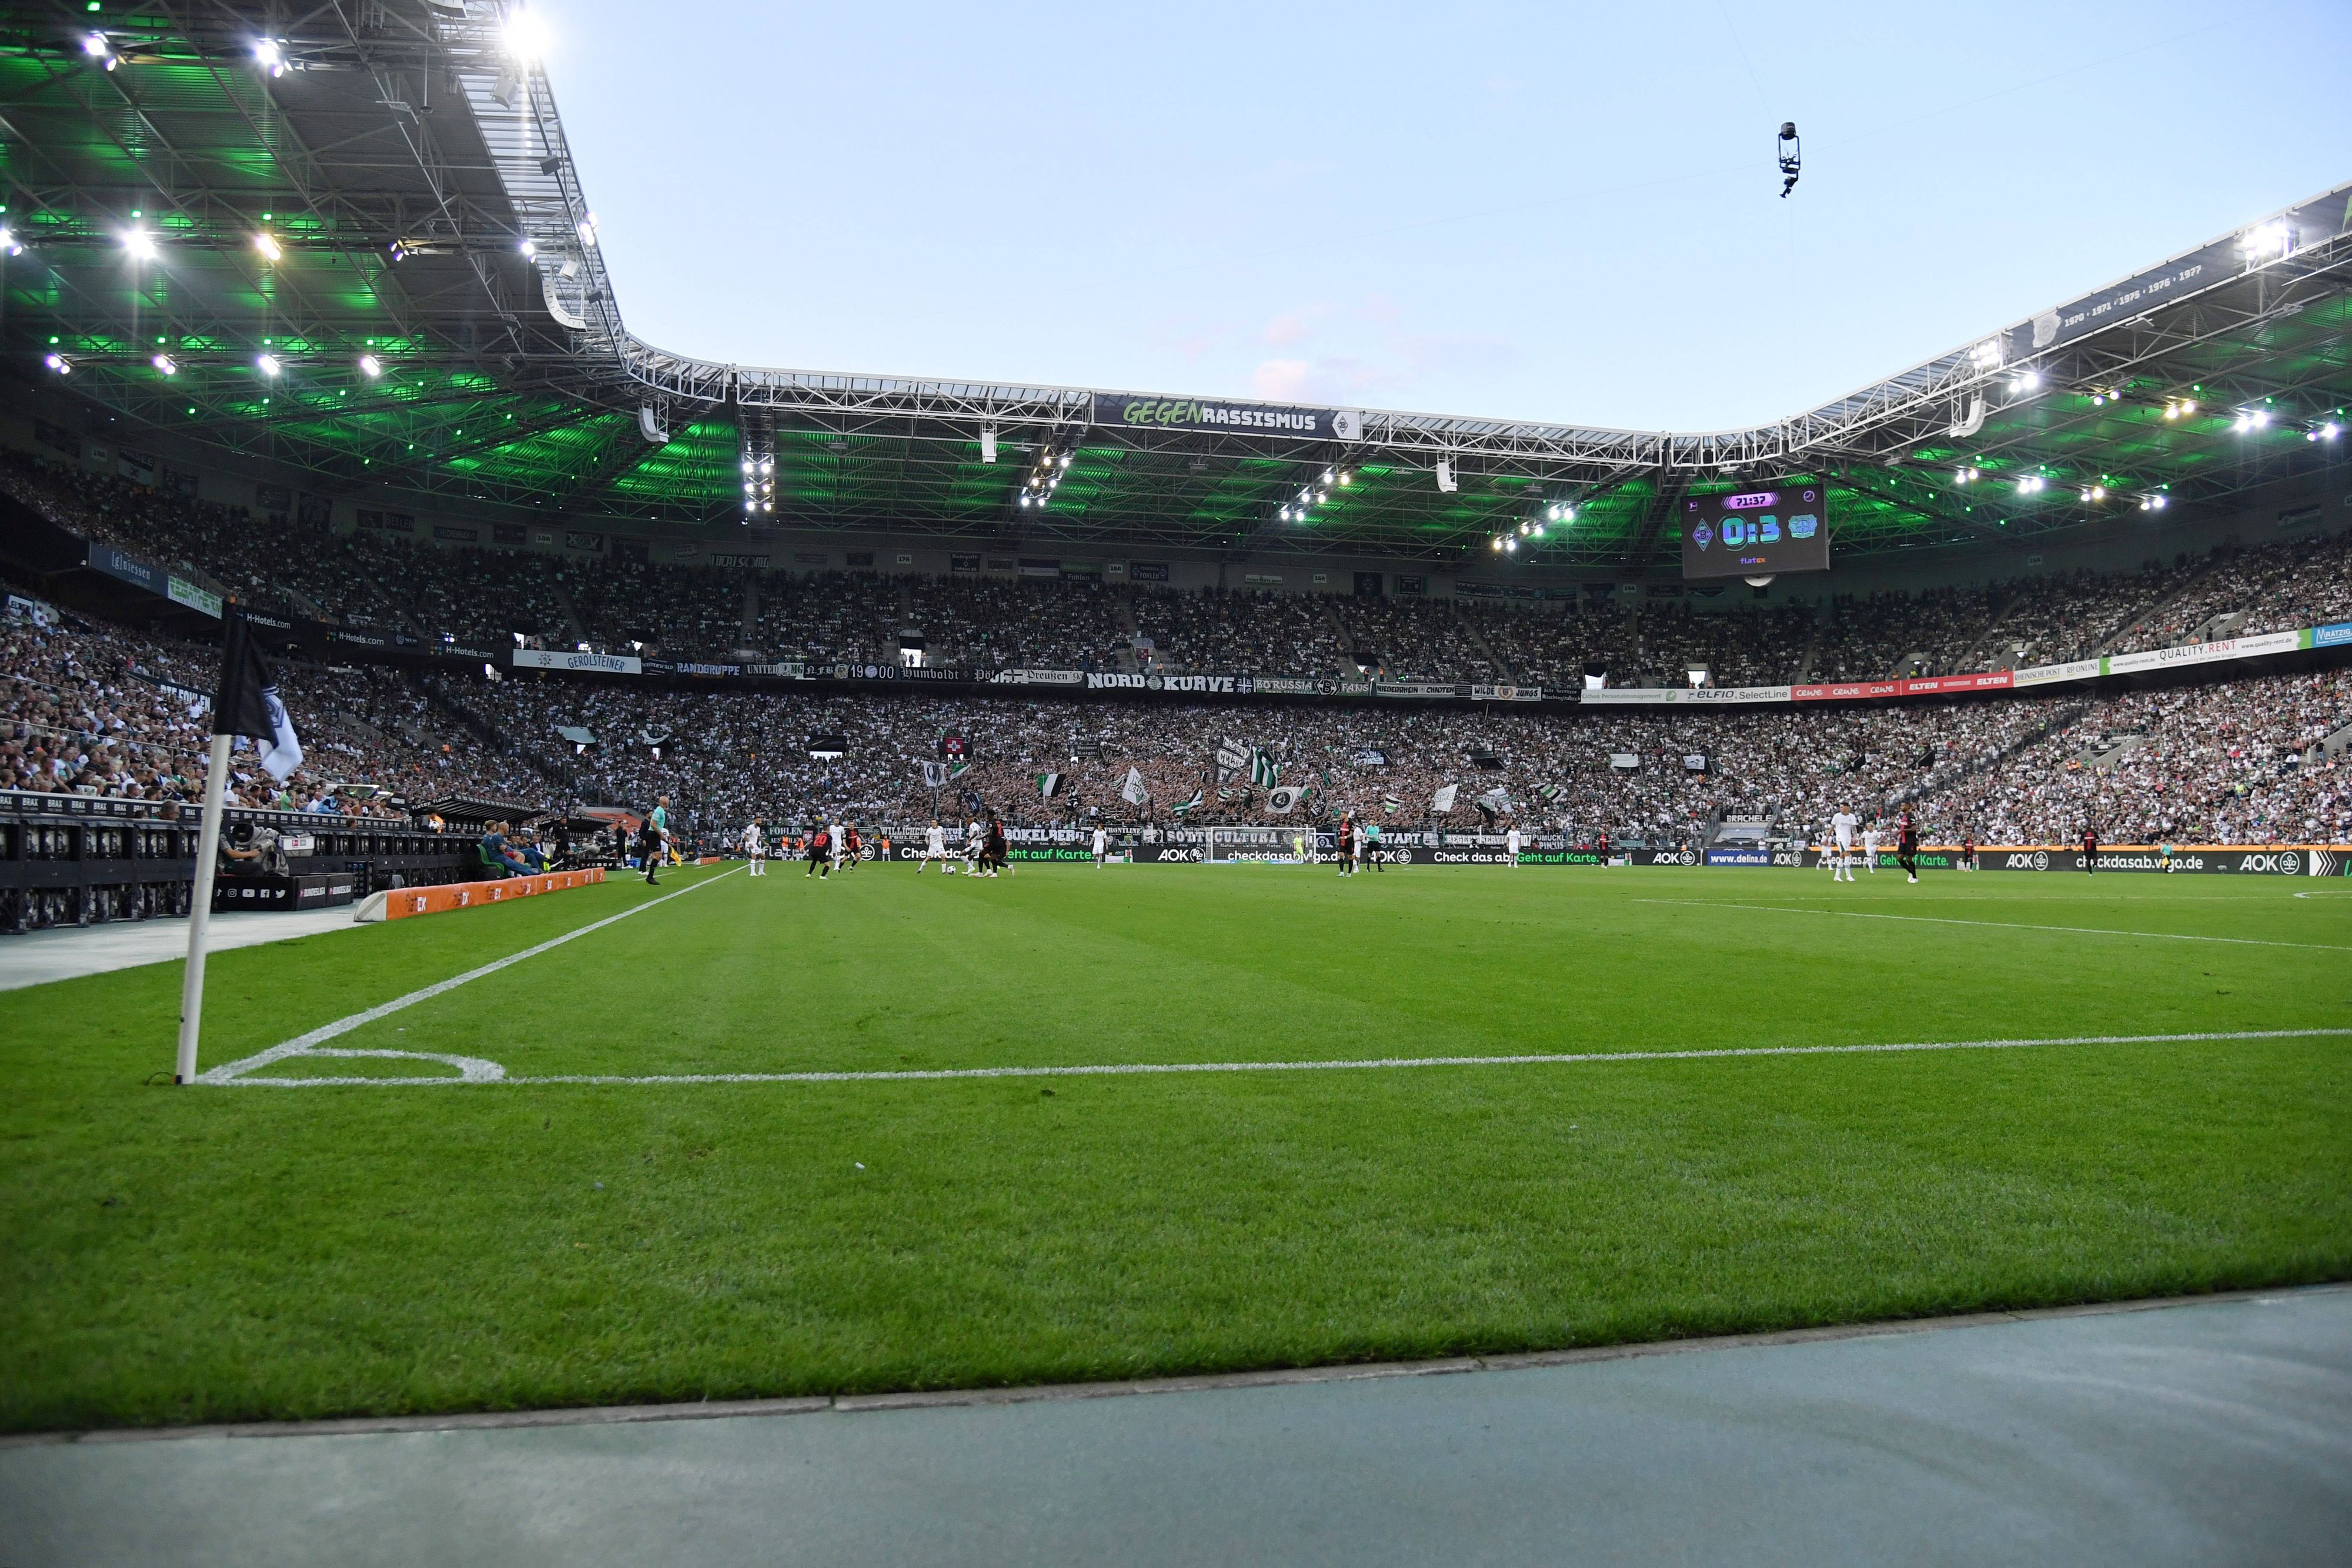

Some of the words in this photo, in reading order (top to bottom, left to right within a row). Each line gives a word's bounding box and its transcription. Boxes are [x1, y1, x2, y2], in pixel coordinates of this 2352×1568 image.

[2064, 312, 2084, 327] 1970
[2092, 302, 2112, 317] 1971
[2119, 290, 2140, 306] 1975
[2148, 278, 2170, 294] 1976
[2179, 265, 2201, 282] 1977
[1123, 401, 1205, 427] GEGEN
[1202, 407, 1316, 430] RASSISMUS
[1736, 496, 1766, 507] 71:37
[1722, 514, 1782, 545] 0:3
[246, 613, 291, 630] H-Hotels.com
[339, 631, 385, 646] H-Hotels.com
[2241, 637, 2292, 650] www.quality-rent.de
[446, 645, 494, 658] H-Hotels.com
[2159, 640, 2236, 661] QUALITY.RENT
[567, 655, 625, 672] GEROLSTEINER
[676, 662, 740, 676] RANDGRUPPE
[747, 664, 779, 675] UNITED
[791, 663, 803, 673] MG
[2066, 666, 2075, 674] RP
[2076, 662, 2099, 673] ONLINE
[2113, 658, 2156, 668] www.quality-rent.de
[850, 665, 863, 678] 19
[879, 666, 894, 679] 00
[901, 667, 959, 681] Humboldt
[1026, 670, 1068, 683] Preußen
[2014, 669, 2045, 682] RHEINISCHE
[2045, 667, 2060, 677] POST
[1087, 673, 1145, 689] NORD
[1163, 676, 1235, 693] KURVE
[1256, 679, 1313, 690] BORUSSIA
[1341, 683, 1369, 693] FANS
[1909, 681, 1939, 690] ELTEN
[1976, 676, 2008, 686] ELTEN
[1377, 686, 1418, 694] NIEDERRHEIN
[1474, 687, 1495, 696] WILDE
[1515, 688, 1538, 697] JUNGS
[1739, 690, 1788, 700] SelectLine
[1796, 688, 1823, 697] cewe
[1832, 687, 1860, 696] cewe
[1870, 686, 1895, 694] cewe
[0, 795, 13, 806] RAX
[22, 797, 39, 807] BRAX
[47, 798, 64, 808] BRAX
[71, 800, 86, 810] BRAX
[93, 801, 108, 811] BRAX
[113, 803, 127, 811] BRAX
[769, 827, 803, 835] FOHLEN
[880, 827, 927, 835] WILLICHER
[1004, 827, 1085, 841] BÖKELBERG
[1214, 831, 1278, 843] CULTURA
[814, 835, 828, 845] 20
[1008, 848, 1028, 860] eht
[1030, 848, 1053, 860] auf
[1056, 848, 1094, 860] Karte.
[1157, 848, 1189, 861] AOK
[1434, 852, 1469, 862] Check
[1471, 852, 1493, 862] das
[1516, 852, 1543, 863] Geht
[1545, 852, 1564, 863] auf
[1566, 852, 1599, 864] Karte.
[1652, 852, 1681, 864] AOK
[1710, 854, 1768, 864] www.delina.de
[1773, 853, 1792, 865] AOK
[1920, 854, 1949, 866] Karte.
[2005, 854, 2034, 868] AOK
[2076, 854, 2204, 873] chckdasab.vgo.de
[2239, 854, 2279, 871] AOK
